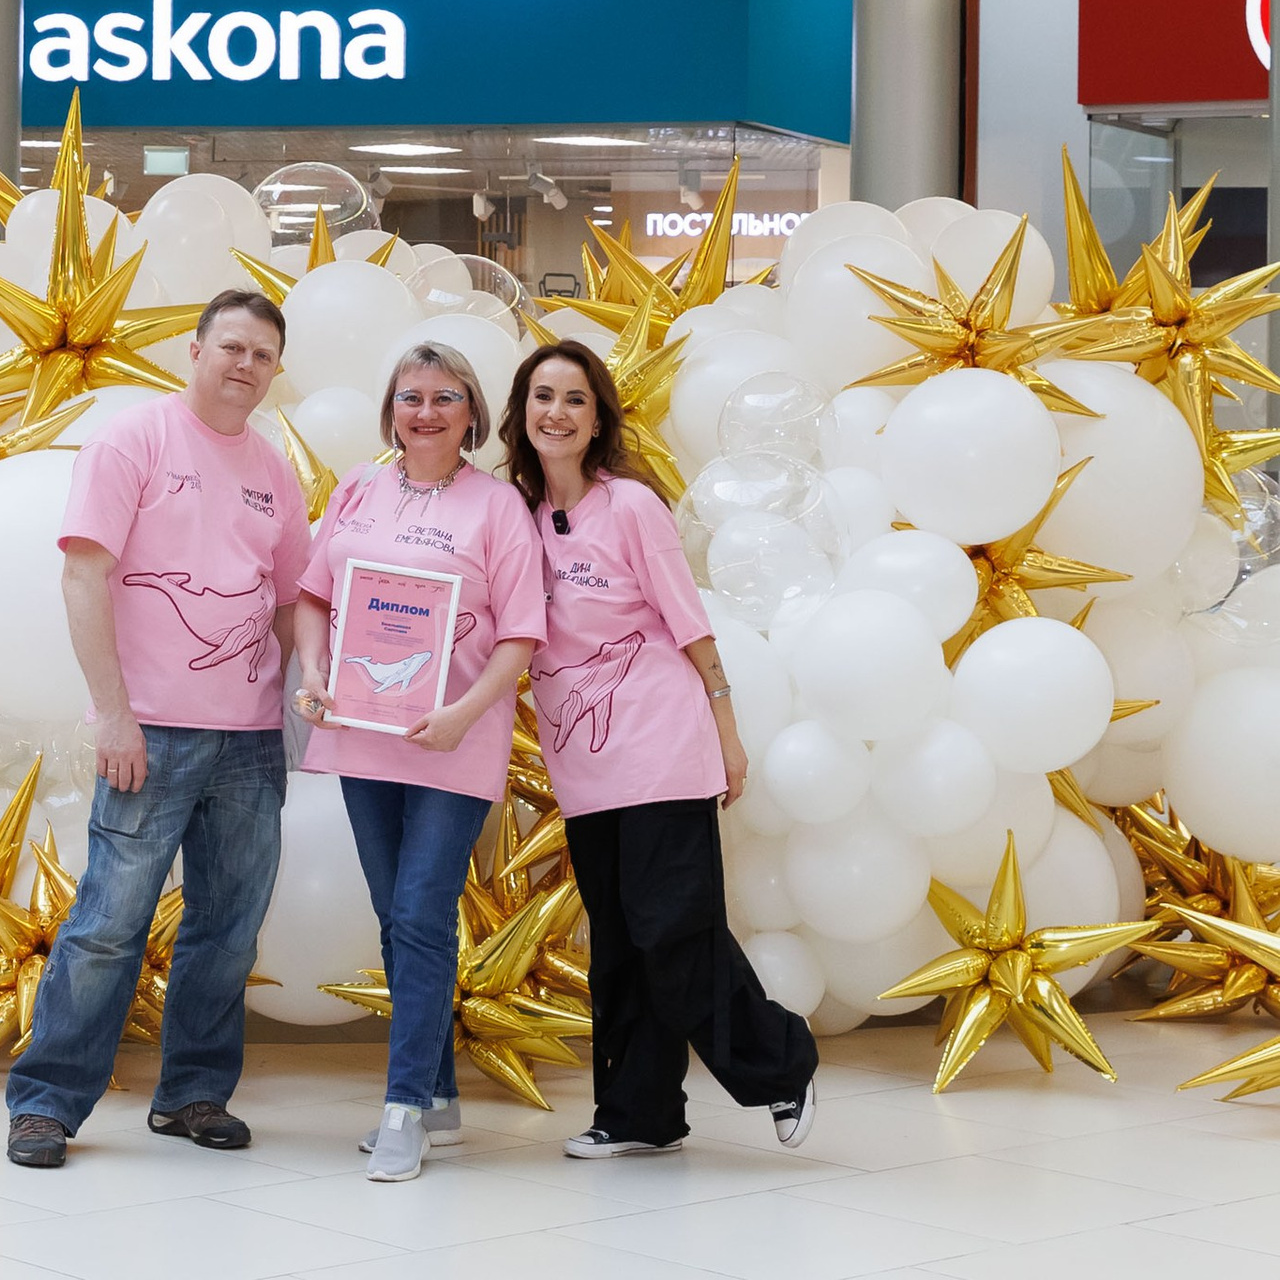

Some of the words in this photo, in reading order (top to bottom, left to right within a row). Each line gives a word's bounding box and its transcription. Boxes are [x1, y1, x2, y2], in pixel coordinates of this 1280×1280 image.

[646, 212, 811, 237] ПОСТЛЬНО
[407, 524, 453, 542] СВЕТЛАНА
[394, 533, 455, 555] ЕМЕЛЬЯНОВА
[368, 597, 430, 617] Диплом
